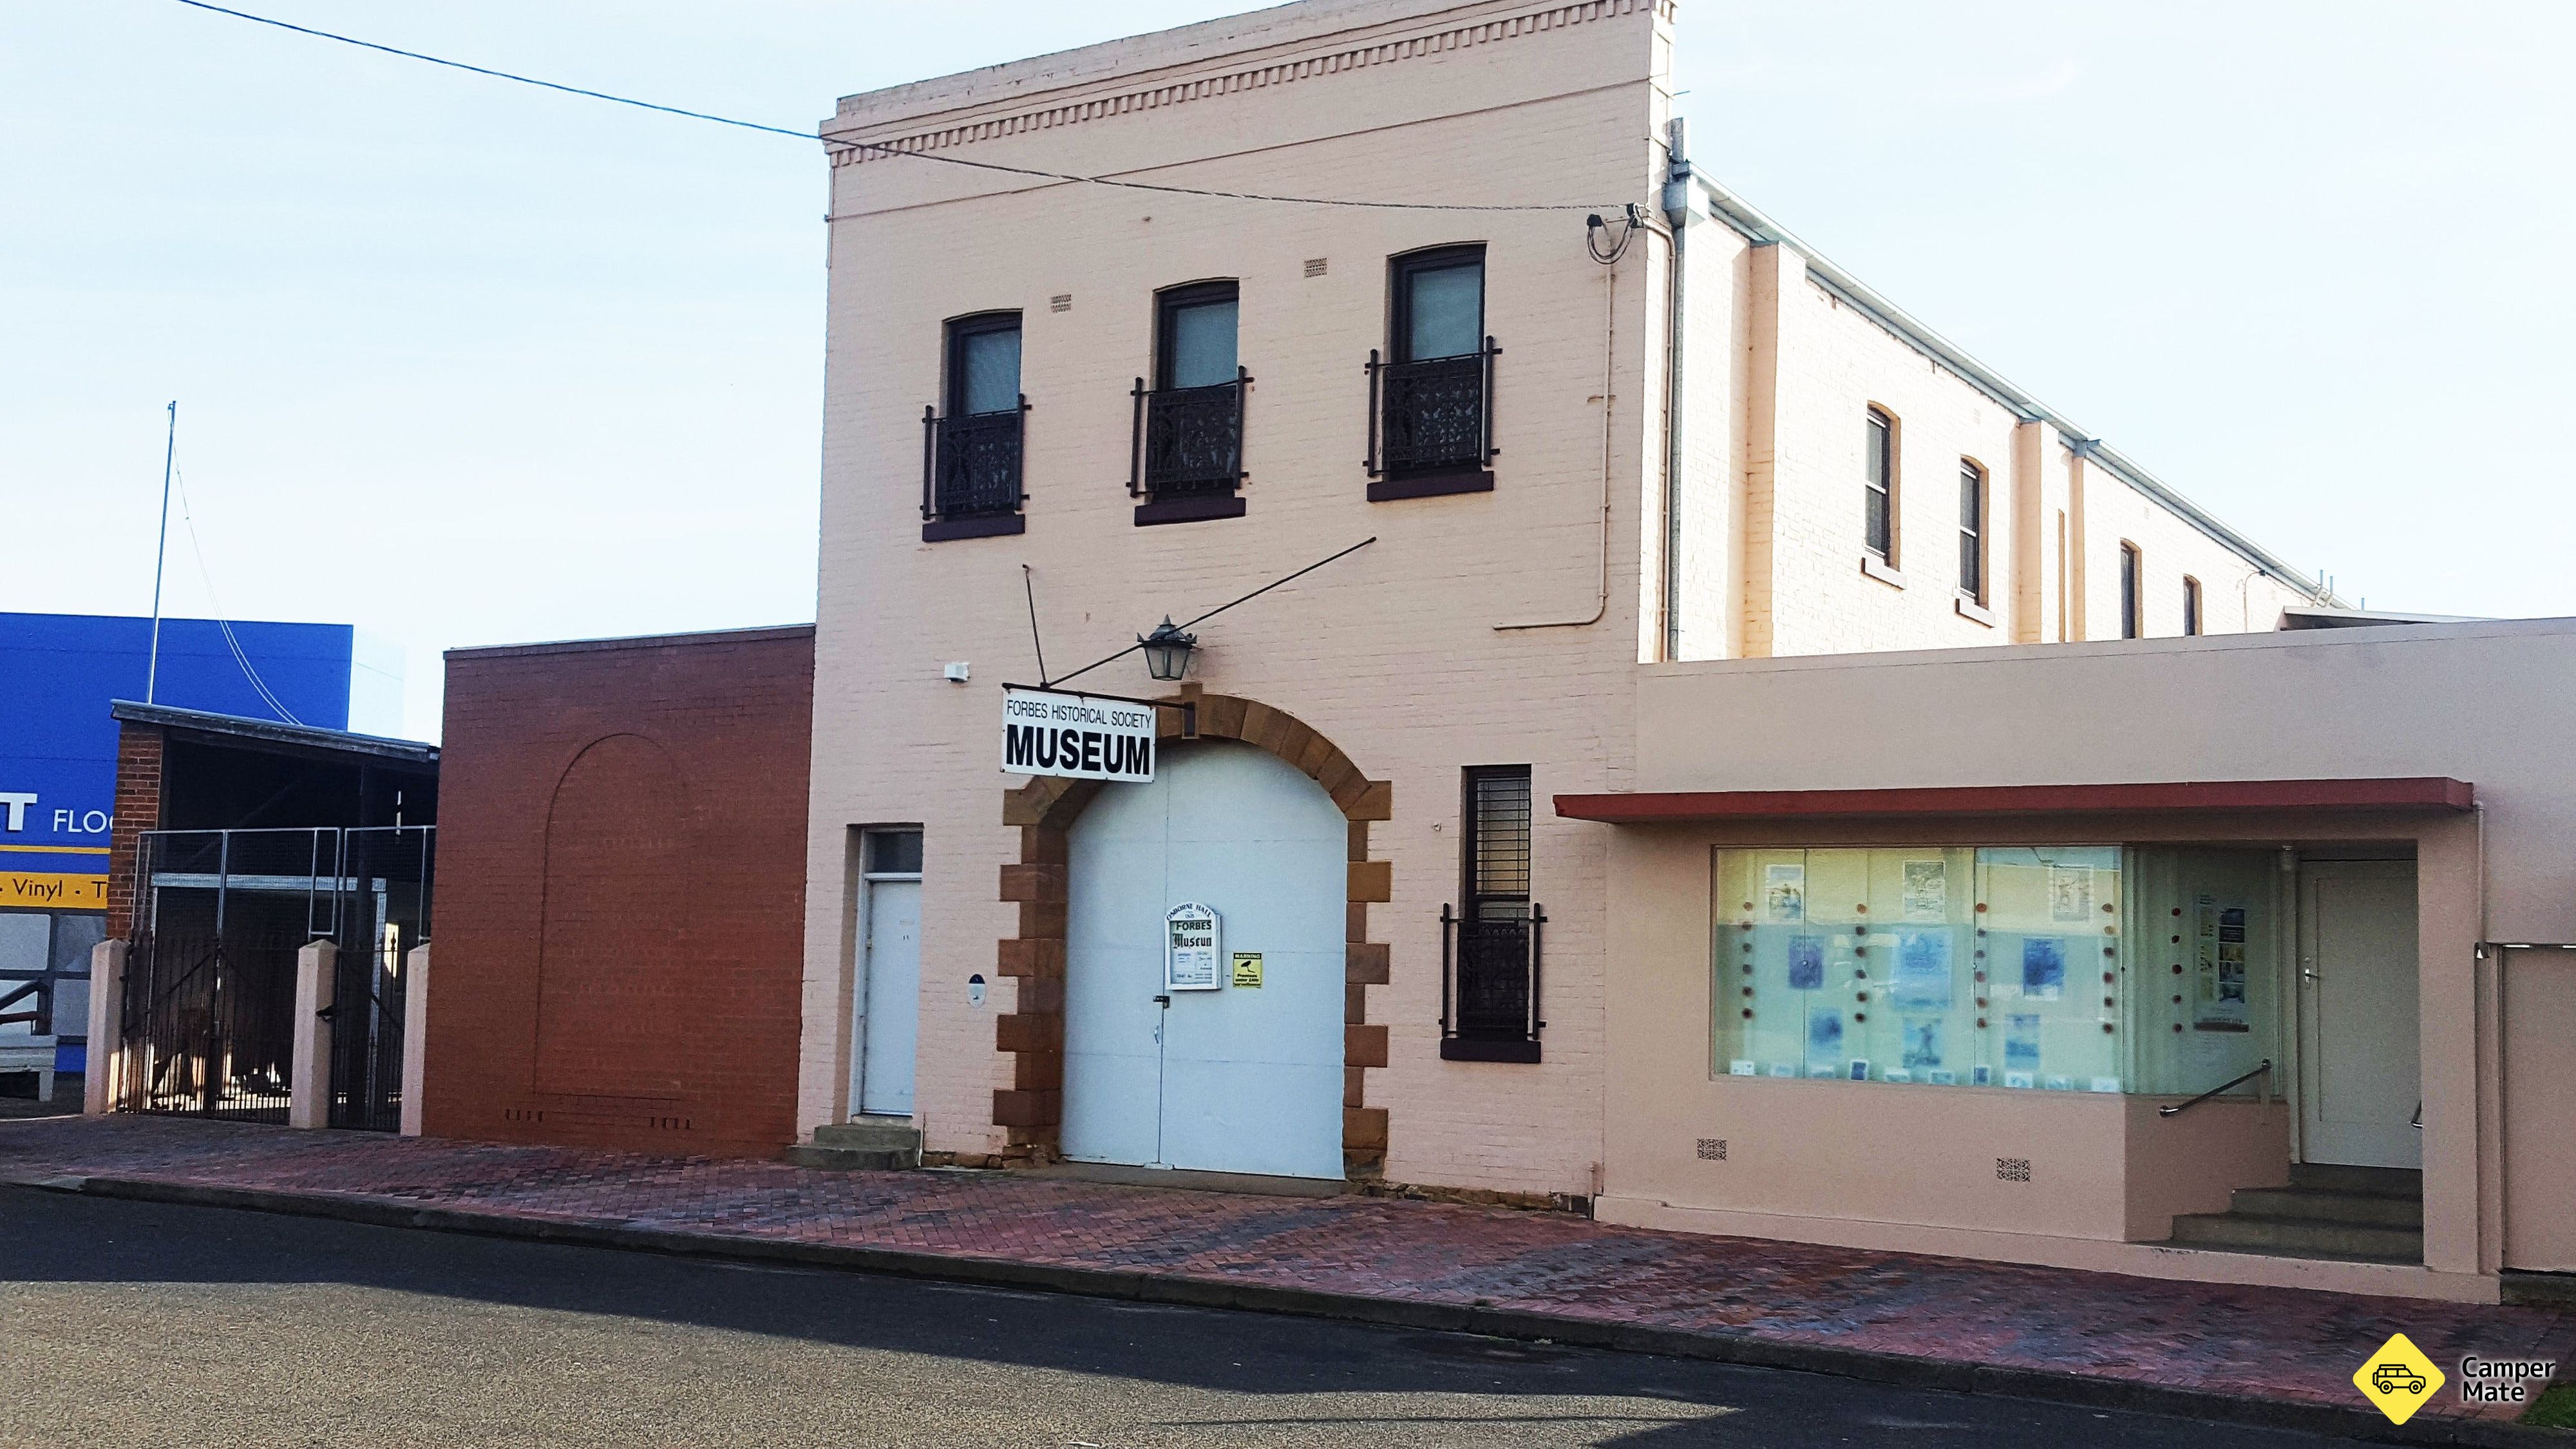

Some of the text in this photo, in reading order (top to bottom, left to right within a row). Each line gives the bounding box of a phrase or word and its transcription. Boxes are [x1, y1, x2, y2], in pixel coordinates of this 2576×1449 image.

[1007, 699, 1151, 728] FORBES HISTORICAL SOCIETY
[1006, 724, 1150, 775] MUSEUM
[53, 809, 113, 833] FLO
[13, 878, 62, 901] Vinyl
[1166, 903, 1212, 921] OSBORNE HALL
[1176, 922, 1212, 931] FORBES
